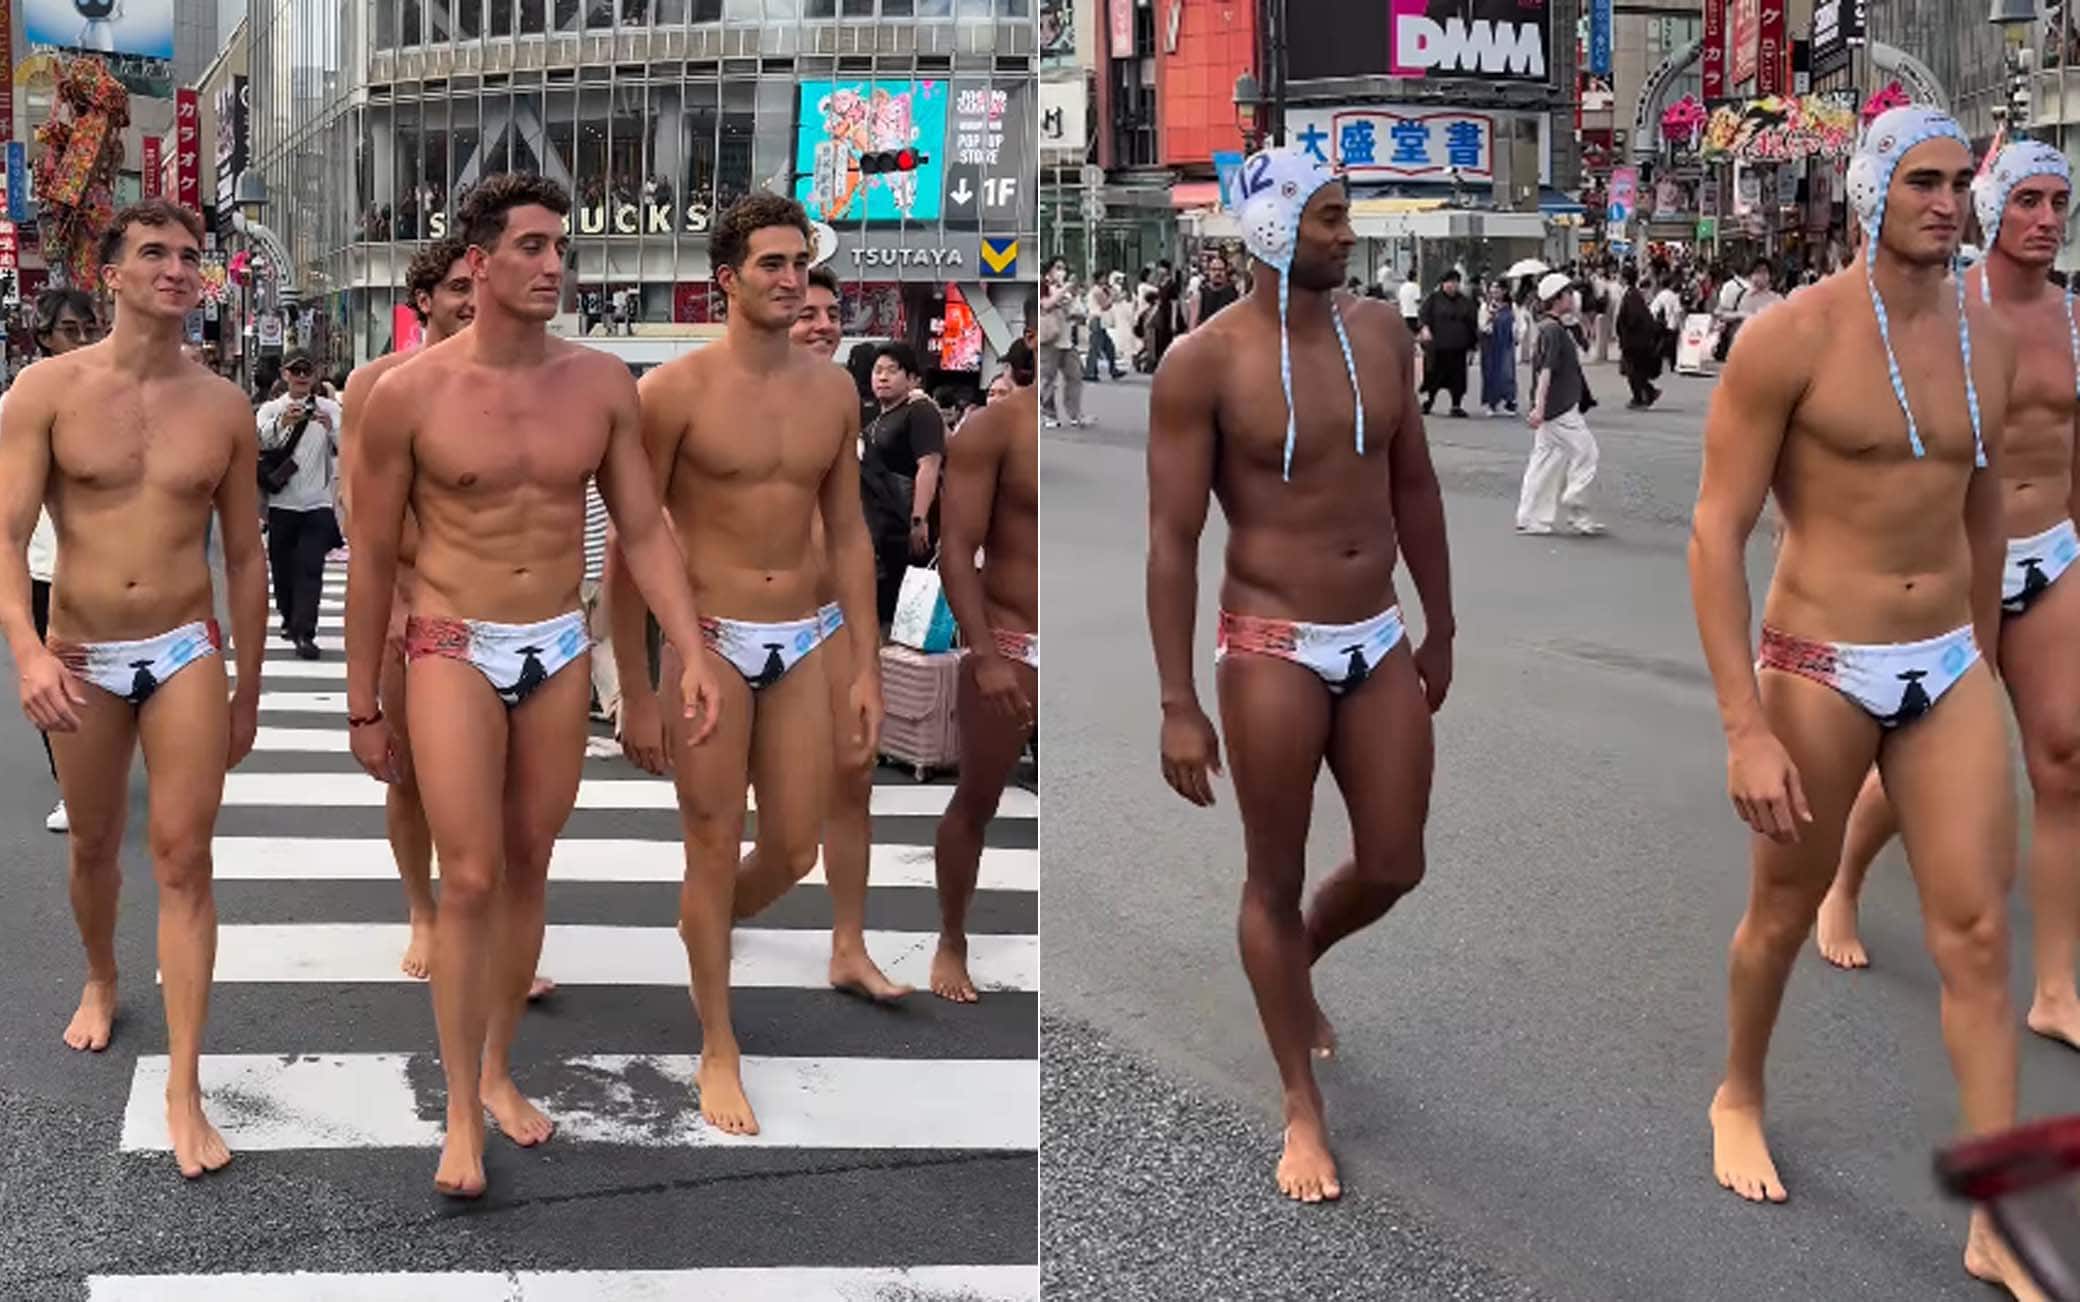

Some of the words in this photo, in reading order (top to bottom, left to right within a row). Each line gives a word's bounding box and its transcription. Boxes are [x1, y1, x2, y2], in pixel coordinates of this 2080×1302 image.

[1396, 13, 1545, 76] DMM
[1296, 118, 1484, 168] 大盛堂書
[982, 177, 1017, 206] 1F
[1239, 154, 1274, 200] 12
[851, 248, 963, 266] TSUTAYA
